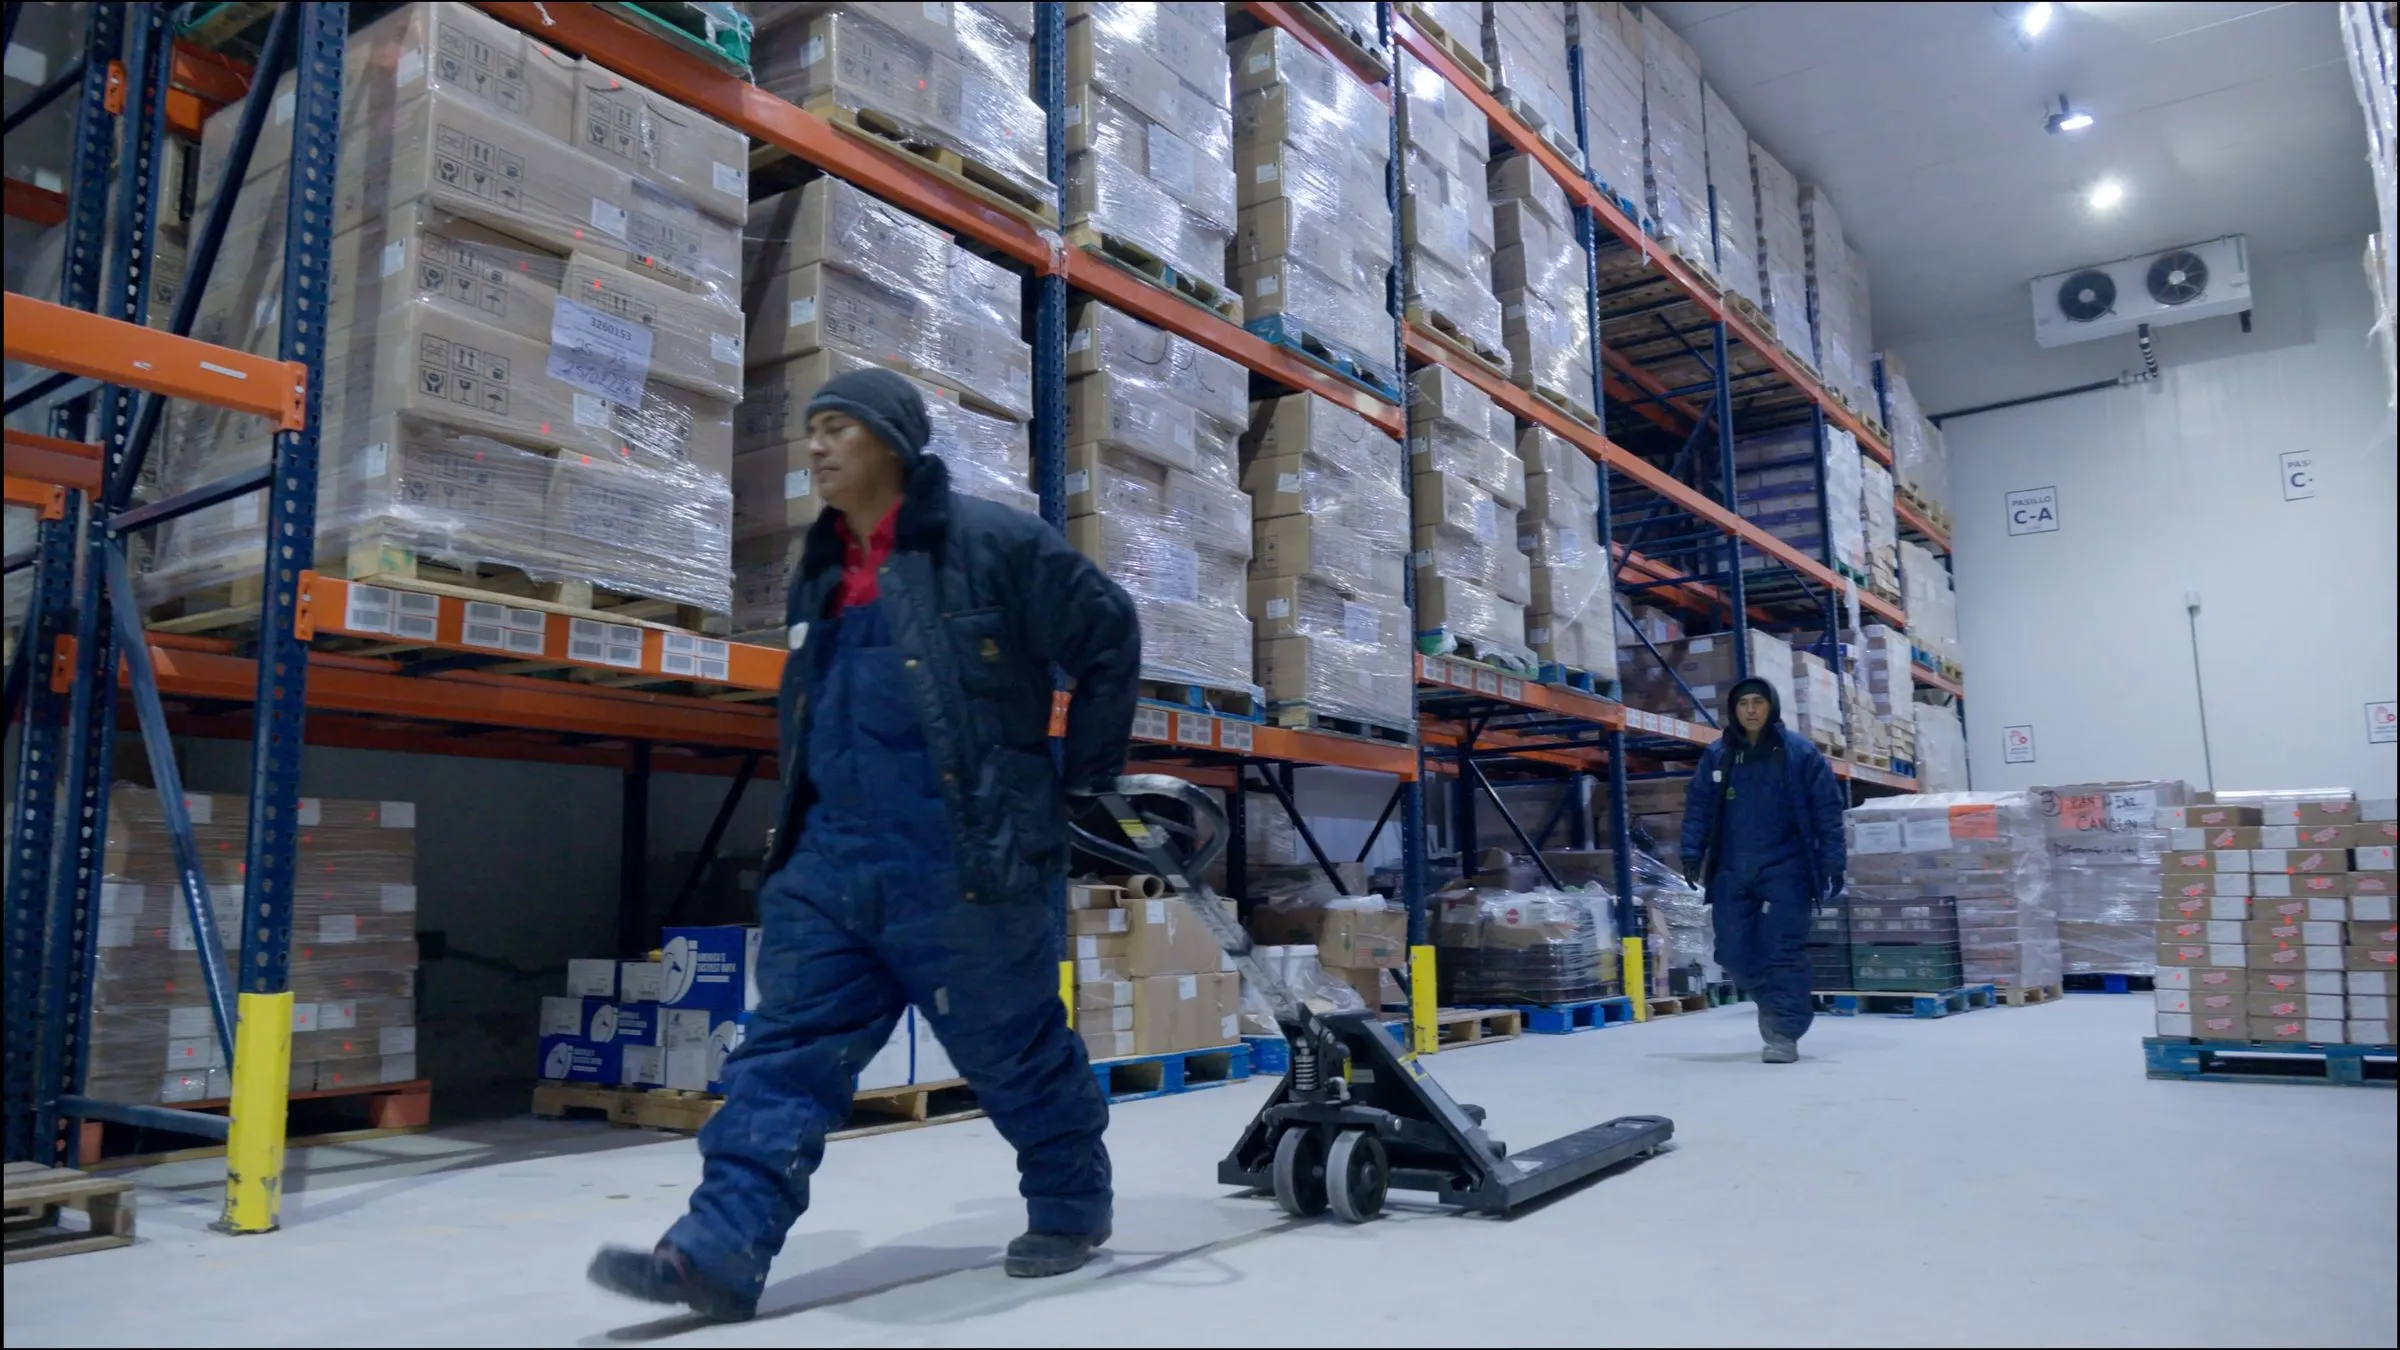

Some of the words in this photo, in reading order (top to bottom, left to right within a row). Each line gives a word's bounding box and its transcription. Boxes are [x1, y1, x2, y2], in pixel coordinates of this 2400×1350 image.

[590, 316, 632, 341] 3260153
[2011, 495, 2052, 507] PASILLO
[2013, 507, 2053, 525] C-A
